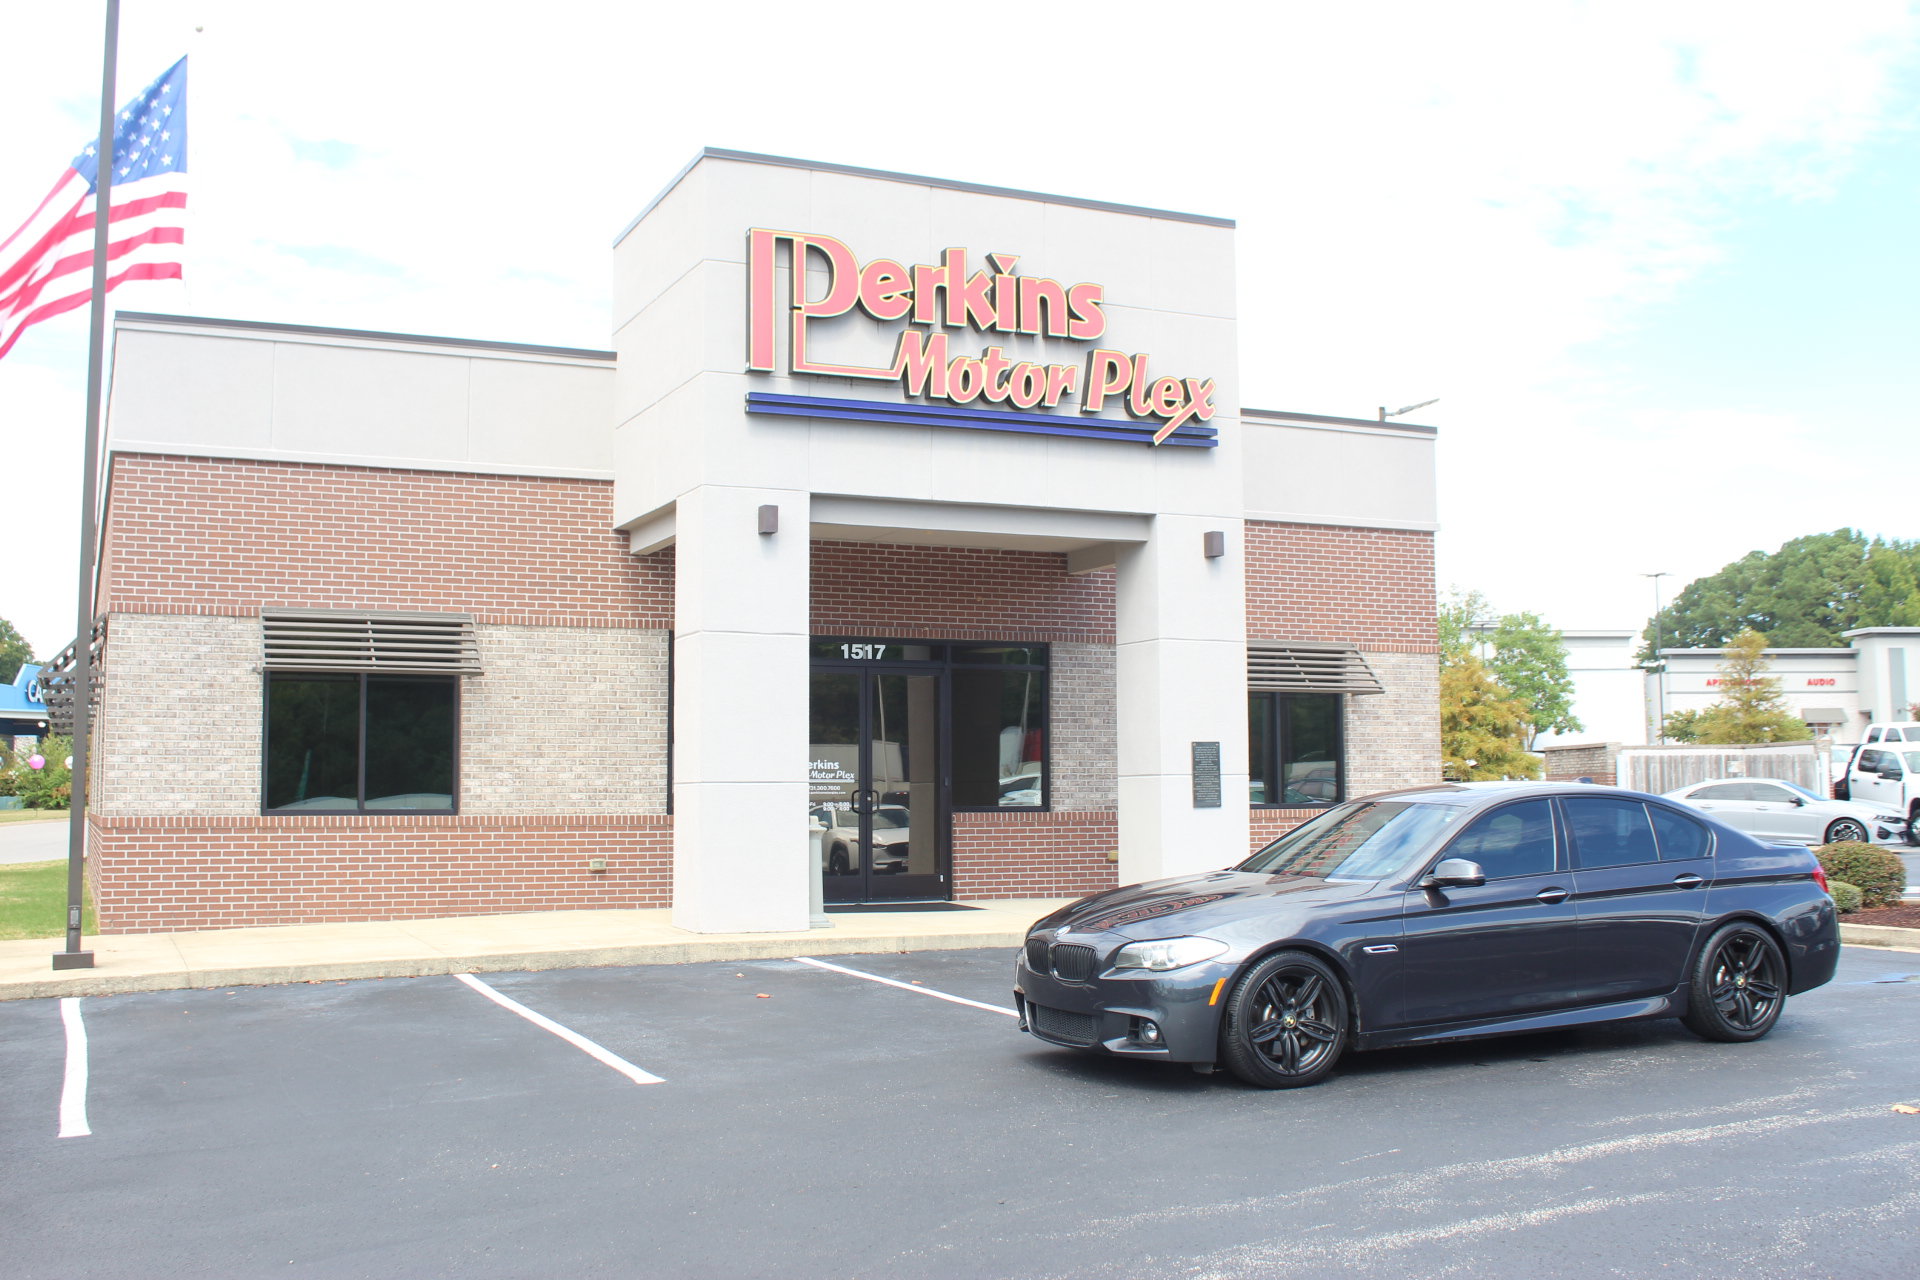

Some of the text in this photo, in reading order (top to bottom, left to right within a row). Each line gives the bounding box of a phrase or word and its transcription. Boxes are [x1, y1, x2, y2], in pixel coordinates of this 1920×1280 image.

[746, 227, 1107, 374] Perkins
[898, 330, 1217, 446] Motor Plex
[841, 643, 886, 660] 1517
[1807, 678, 1836, 687] AUDIO
[27, 679, 47, 704] CA
[808, 759, 840, 770] erkins
[811, 770, 855, 781] Motor Plex
